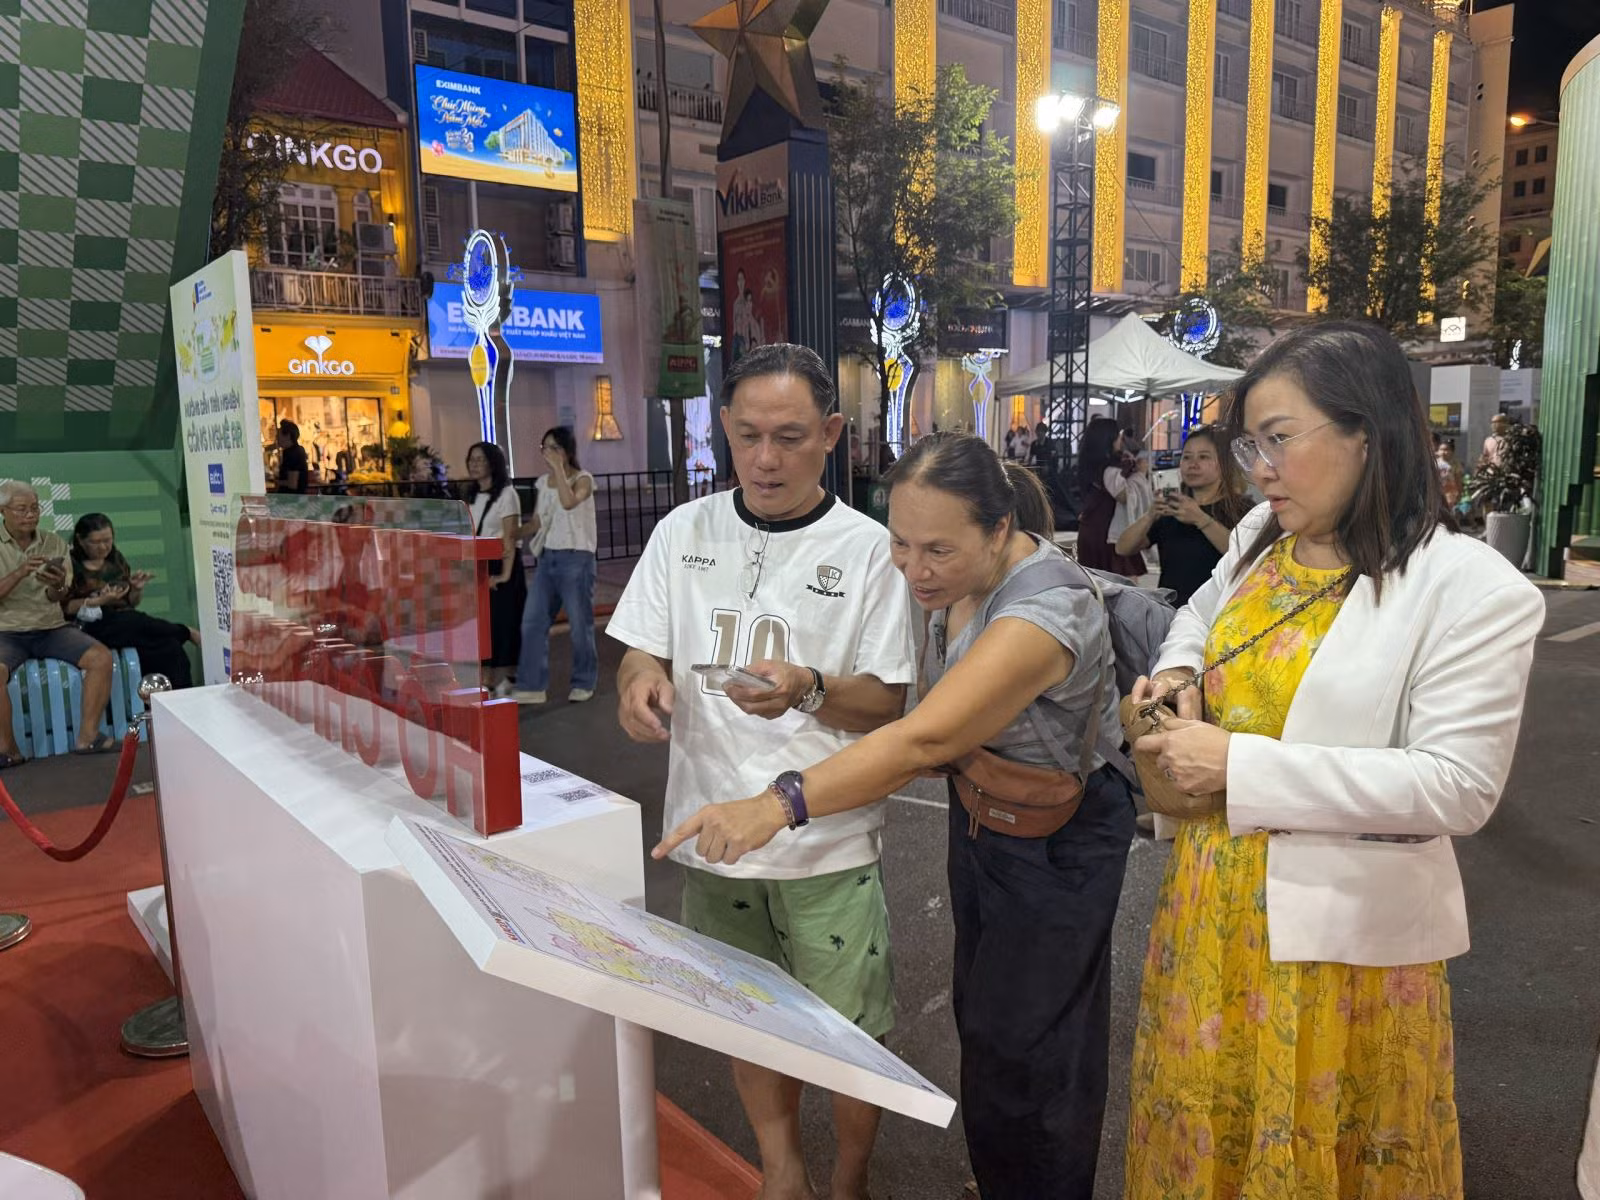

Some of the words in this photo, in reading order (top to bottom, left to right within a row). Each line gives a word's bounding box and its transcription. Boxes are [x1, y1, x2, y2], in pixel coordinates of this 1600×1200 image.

[435, 79, 481, 95] EXIMBANK
[715, 168, 759, 217] Vikki
[760, 187, 784, 205] Bank
[447, 302, 585, 331] EBANK
[681, 554, 716, 567] KAPPA
